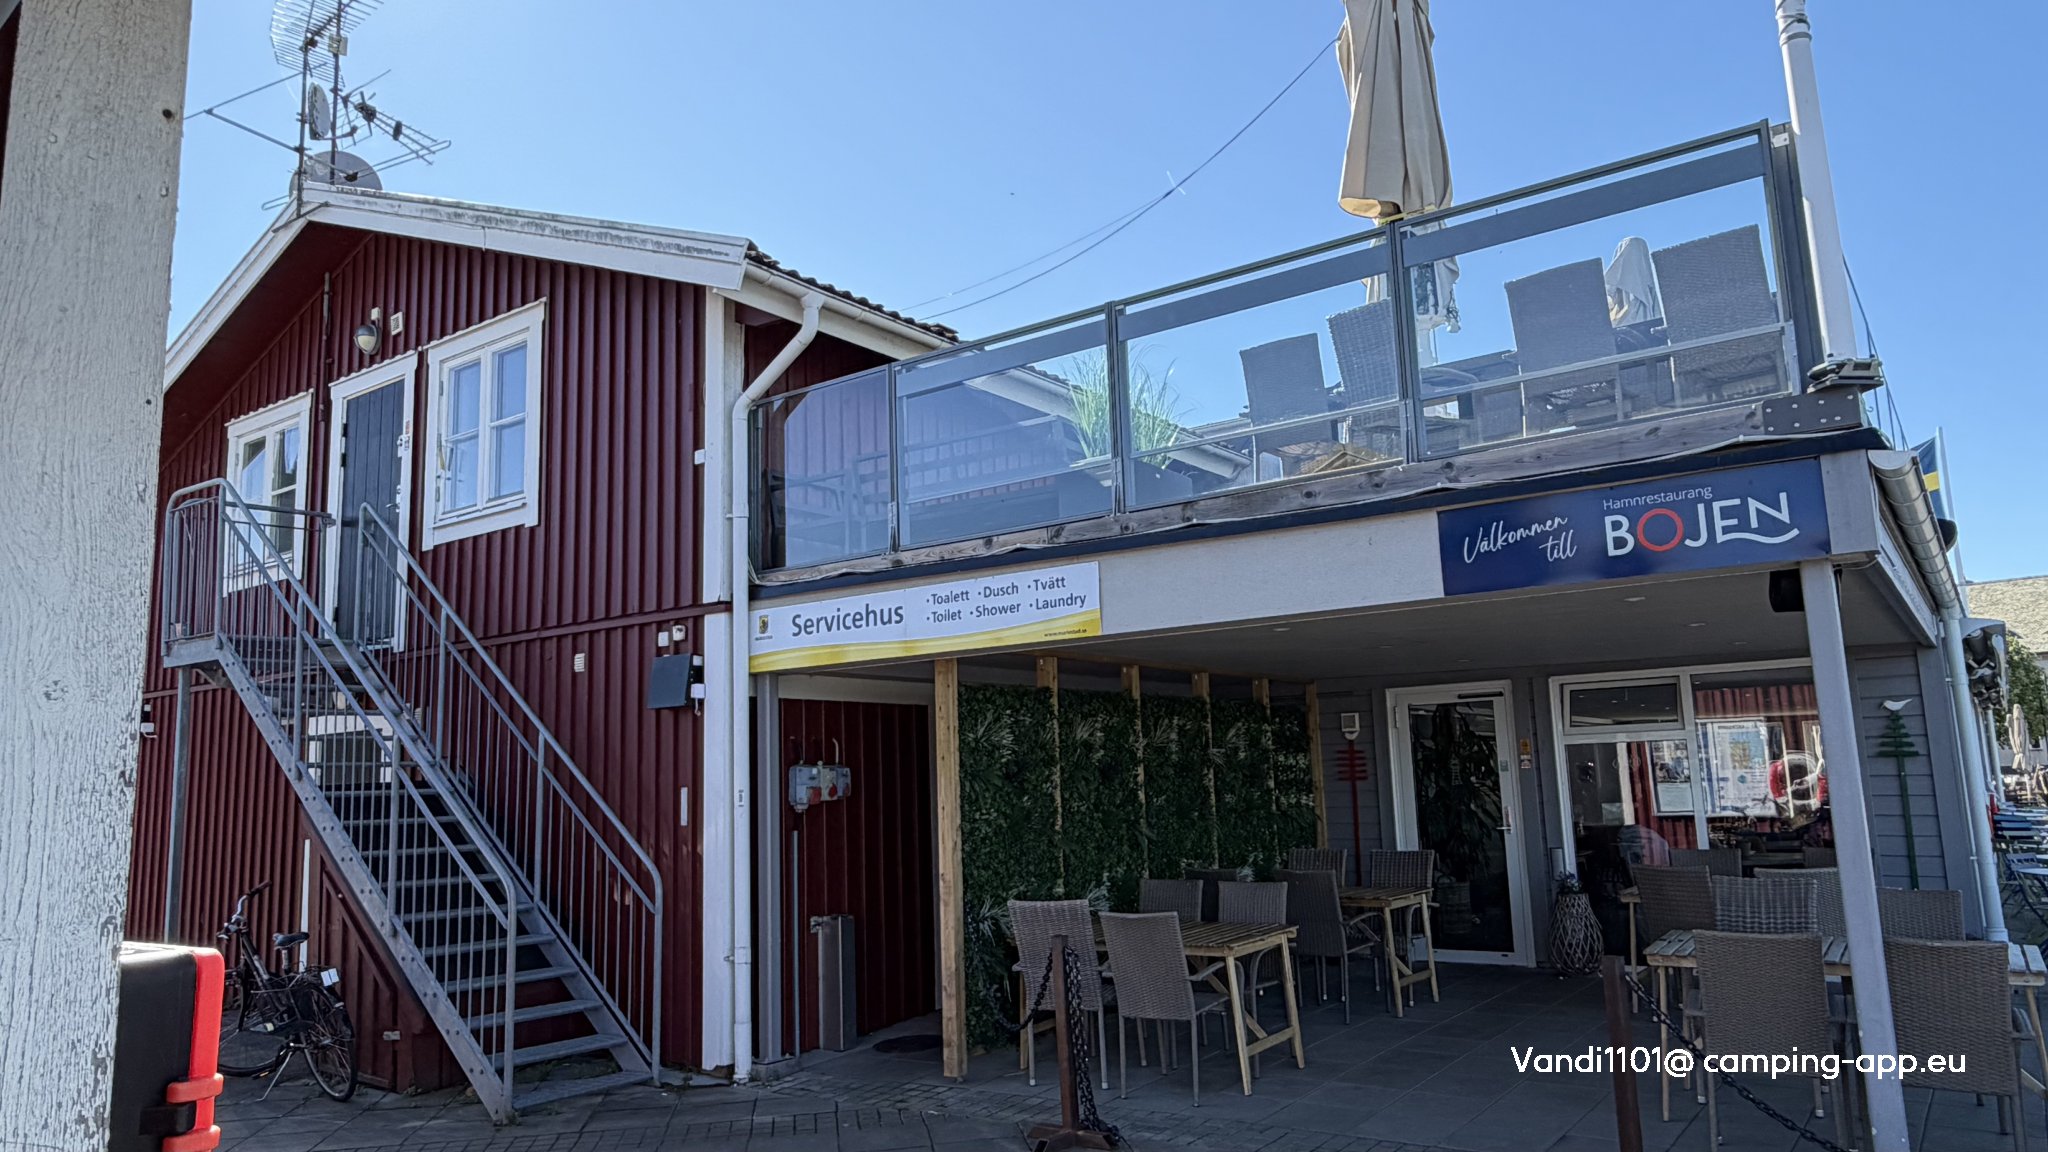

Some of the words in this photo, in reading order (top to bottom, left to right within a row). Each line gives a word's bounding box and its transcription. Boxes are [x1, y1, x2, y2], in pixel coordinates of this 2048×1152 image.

[1603, 486, 1713, 511] Hamnrestaurang
[1463, 515, 1568, 563] Välkommen
[1604, 491, 1799, 557] BOJEN
[1539, 530, 1577, 562] till
[931, 590, 970, 605] Toalett
[983, 582, 1019, 598] Dusch
[1033, 576, 1066, 591] Tvätt
[792, 604, 904, 637] Servicehus
[931, 608, 962, 623] Toilet
[975, 603, 1021, 618] Shower
[1035, 593, 1086, 611] Laundry
